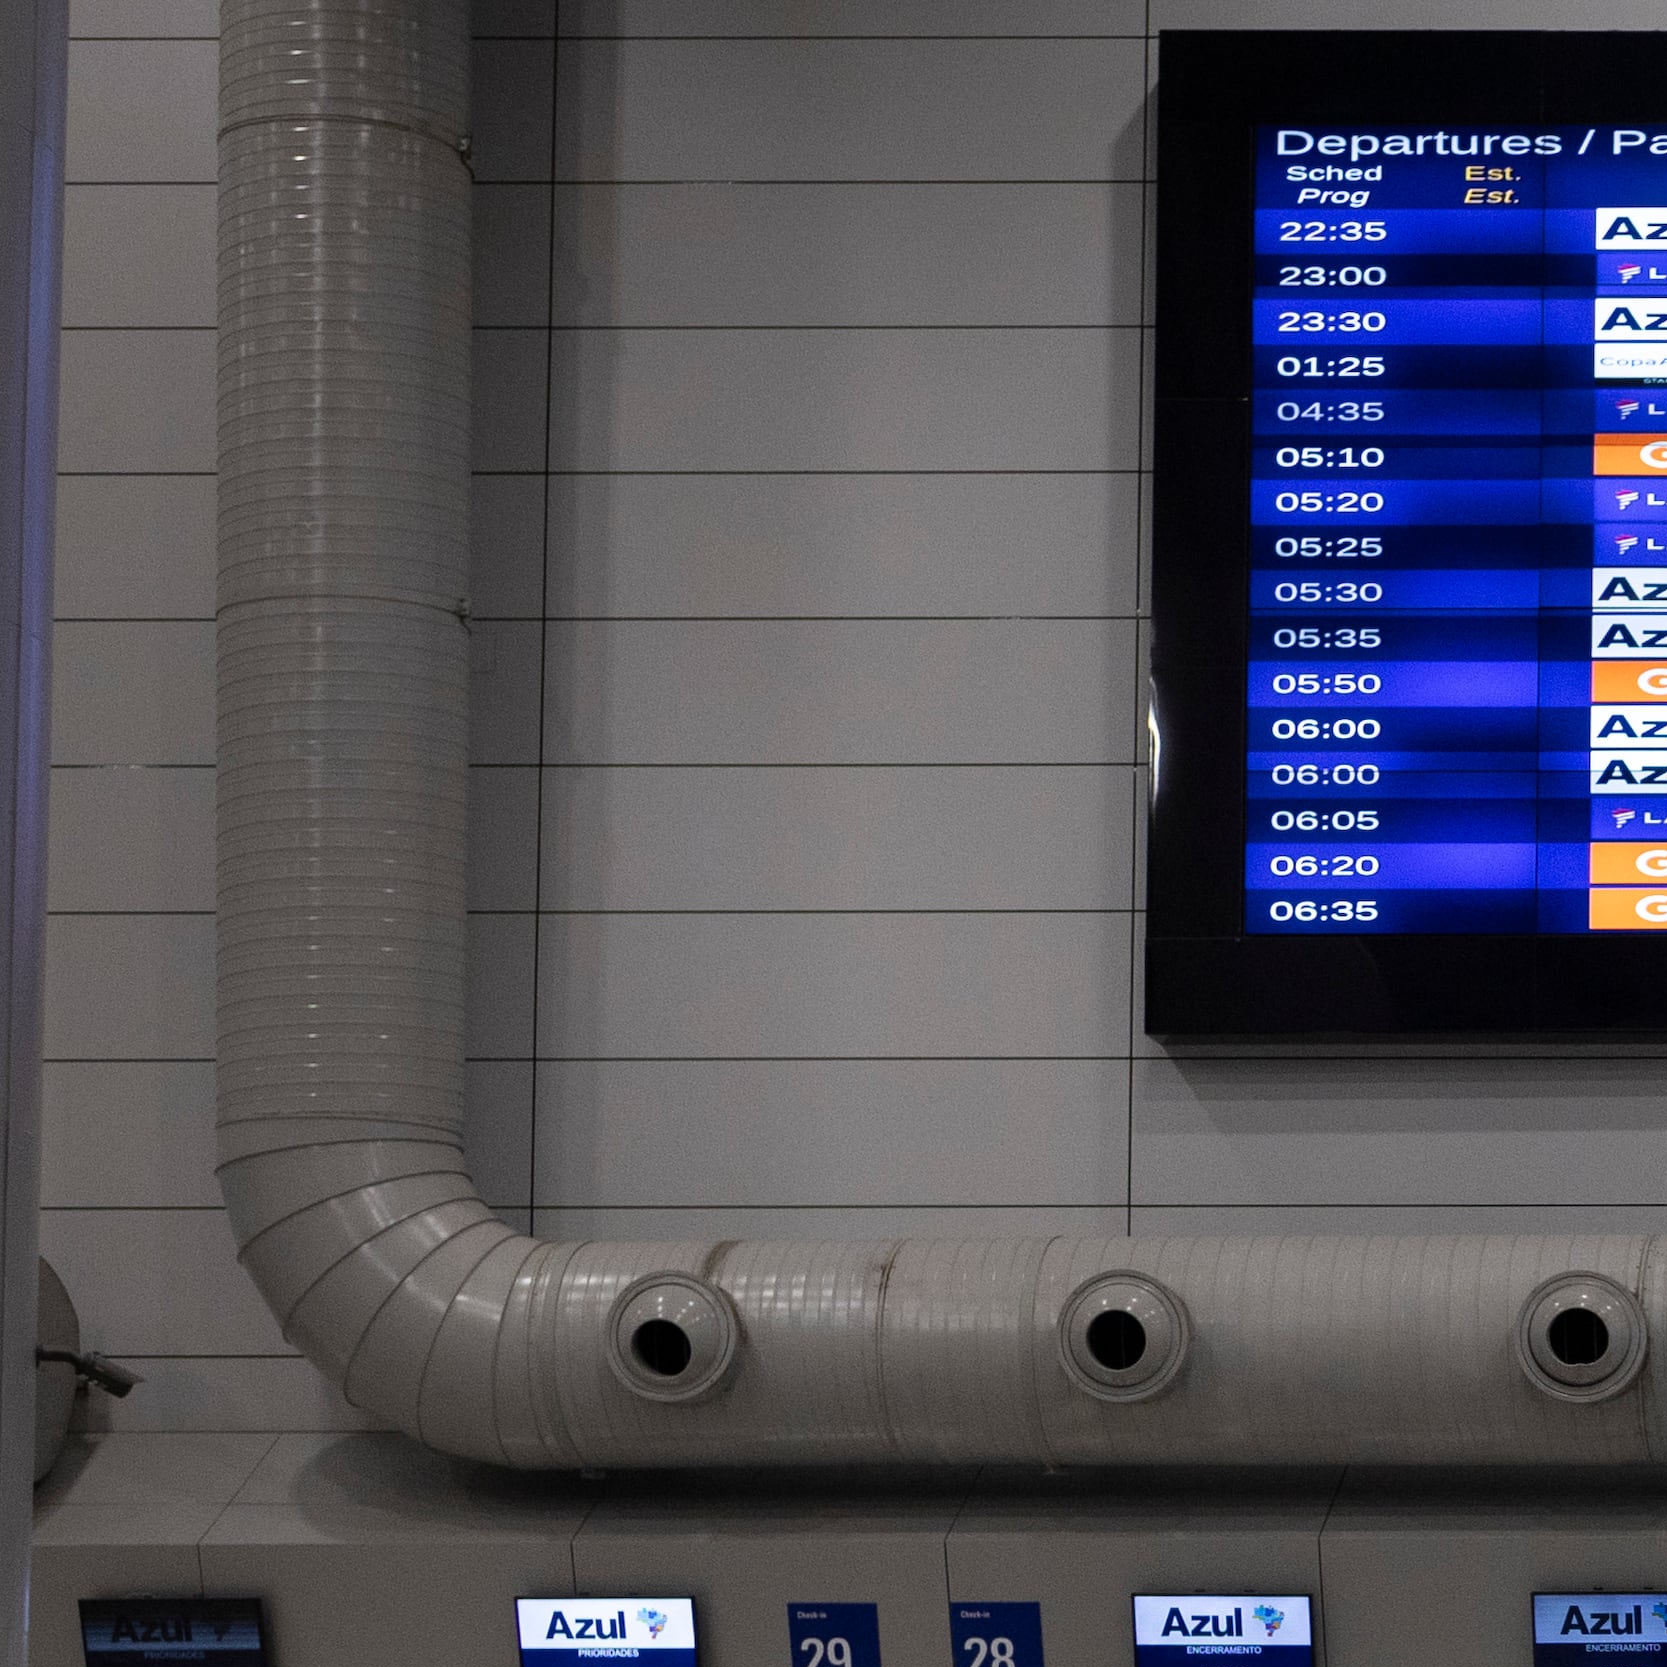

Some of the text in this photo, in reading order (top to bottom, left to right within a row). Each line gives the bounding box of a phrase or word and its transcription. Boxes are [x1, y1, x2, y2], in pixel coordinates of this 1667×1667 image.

[1277, 130, 1562, 162] Departures
[1577, 128, 1596, 155] /
[1286, 164, 1383, 182] Sched
[1464, 165, 1521, 182] Est.
[1297, 187, 1370, 209] Prog
[1463, 187, 1519, 204] Est.
[1279, 221, 1387, 242] 22:35
[1276, 356, 1386, 377] 01:25
[1275, 447, 1385, 468] 05:10
[1272, 673, 1382, 694] 05:50
[1271, 718, 1381, 740] 06:00
[1270, 810, 1380, 831] 06:05
[546, 1611, 627, 1640] Azul
[1161, 1607, 1243, 1638] Azul
[578, 1648, 640, 1658] PRIORIDADES
[1186, 1646, 1262, 1655] ENCERRAMENTO
